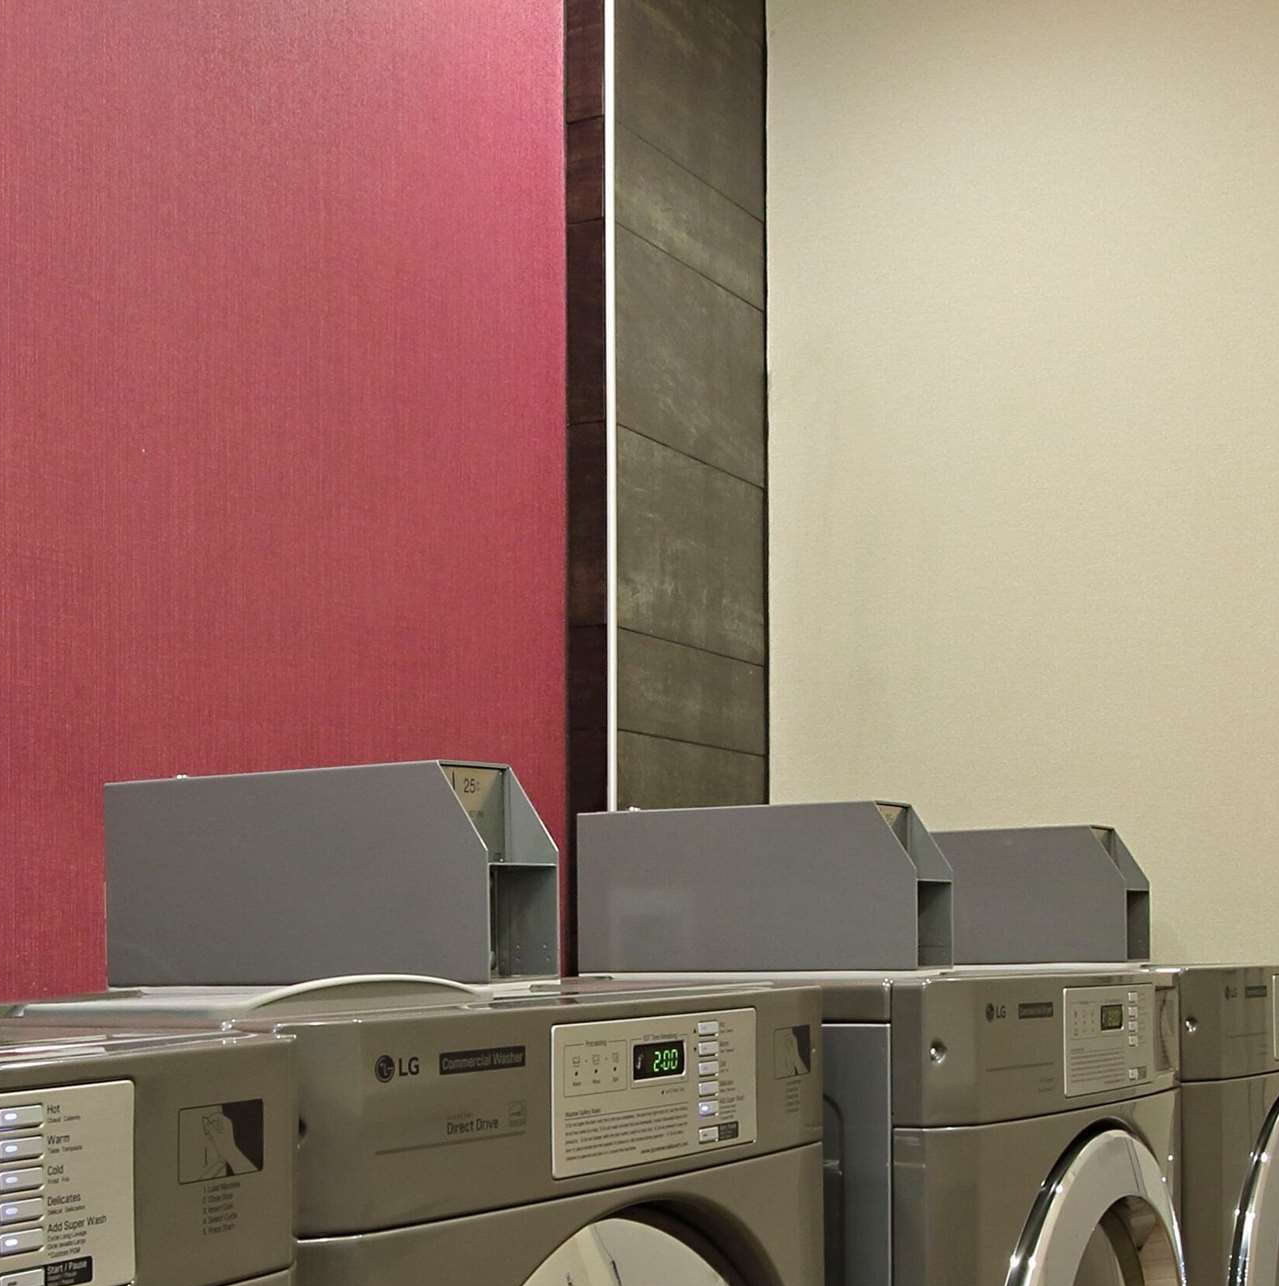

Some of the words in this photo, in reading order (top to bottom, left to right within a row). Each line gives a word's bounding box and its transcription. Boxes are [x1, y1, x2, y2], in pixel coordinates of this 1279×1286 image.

[398, 1056, 420, 1077] LG
[441, 1054, 491, 1072] Commercial
[47, 1105, 60, 1114] Hot
[476, 1118, 499, 1131] Drive
[47, 1135, 70, 1145] Warm
[47, 1165, 64, 1176] Cold
[47, 1194, 81, 1207] Delicates
[47, 1223, 63, 1233] Add
[64, 1219, 85, 1231] Super
[86, 1215, 108, 1225] Wash
